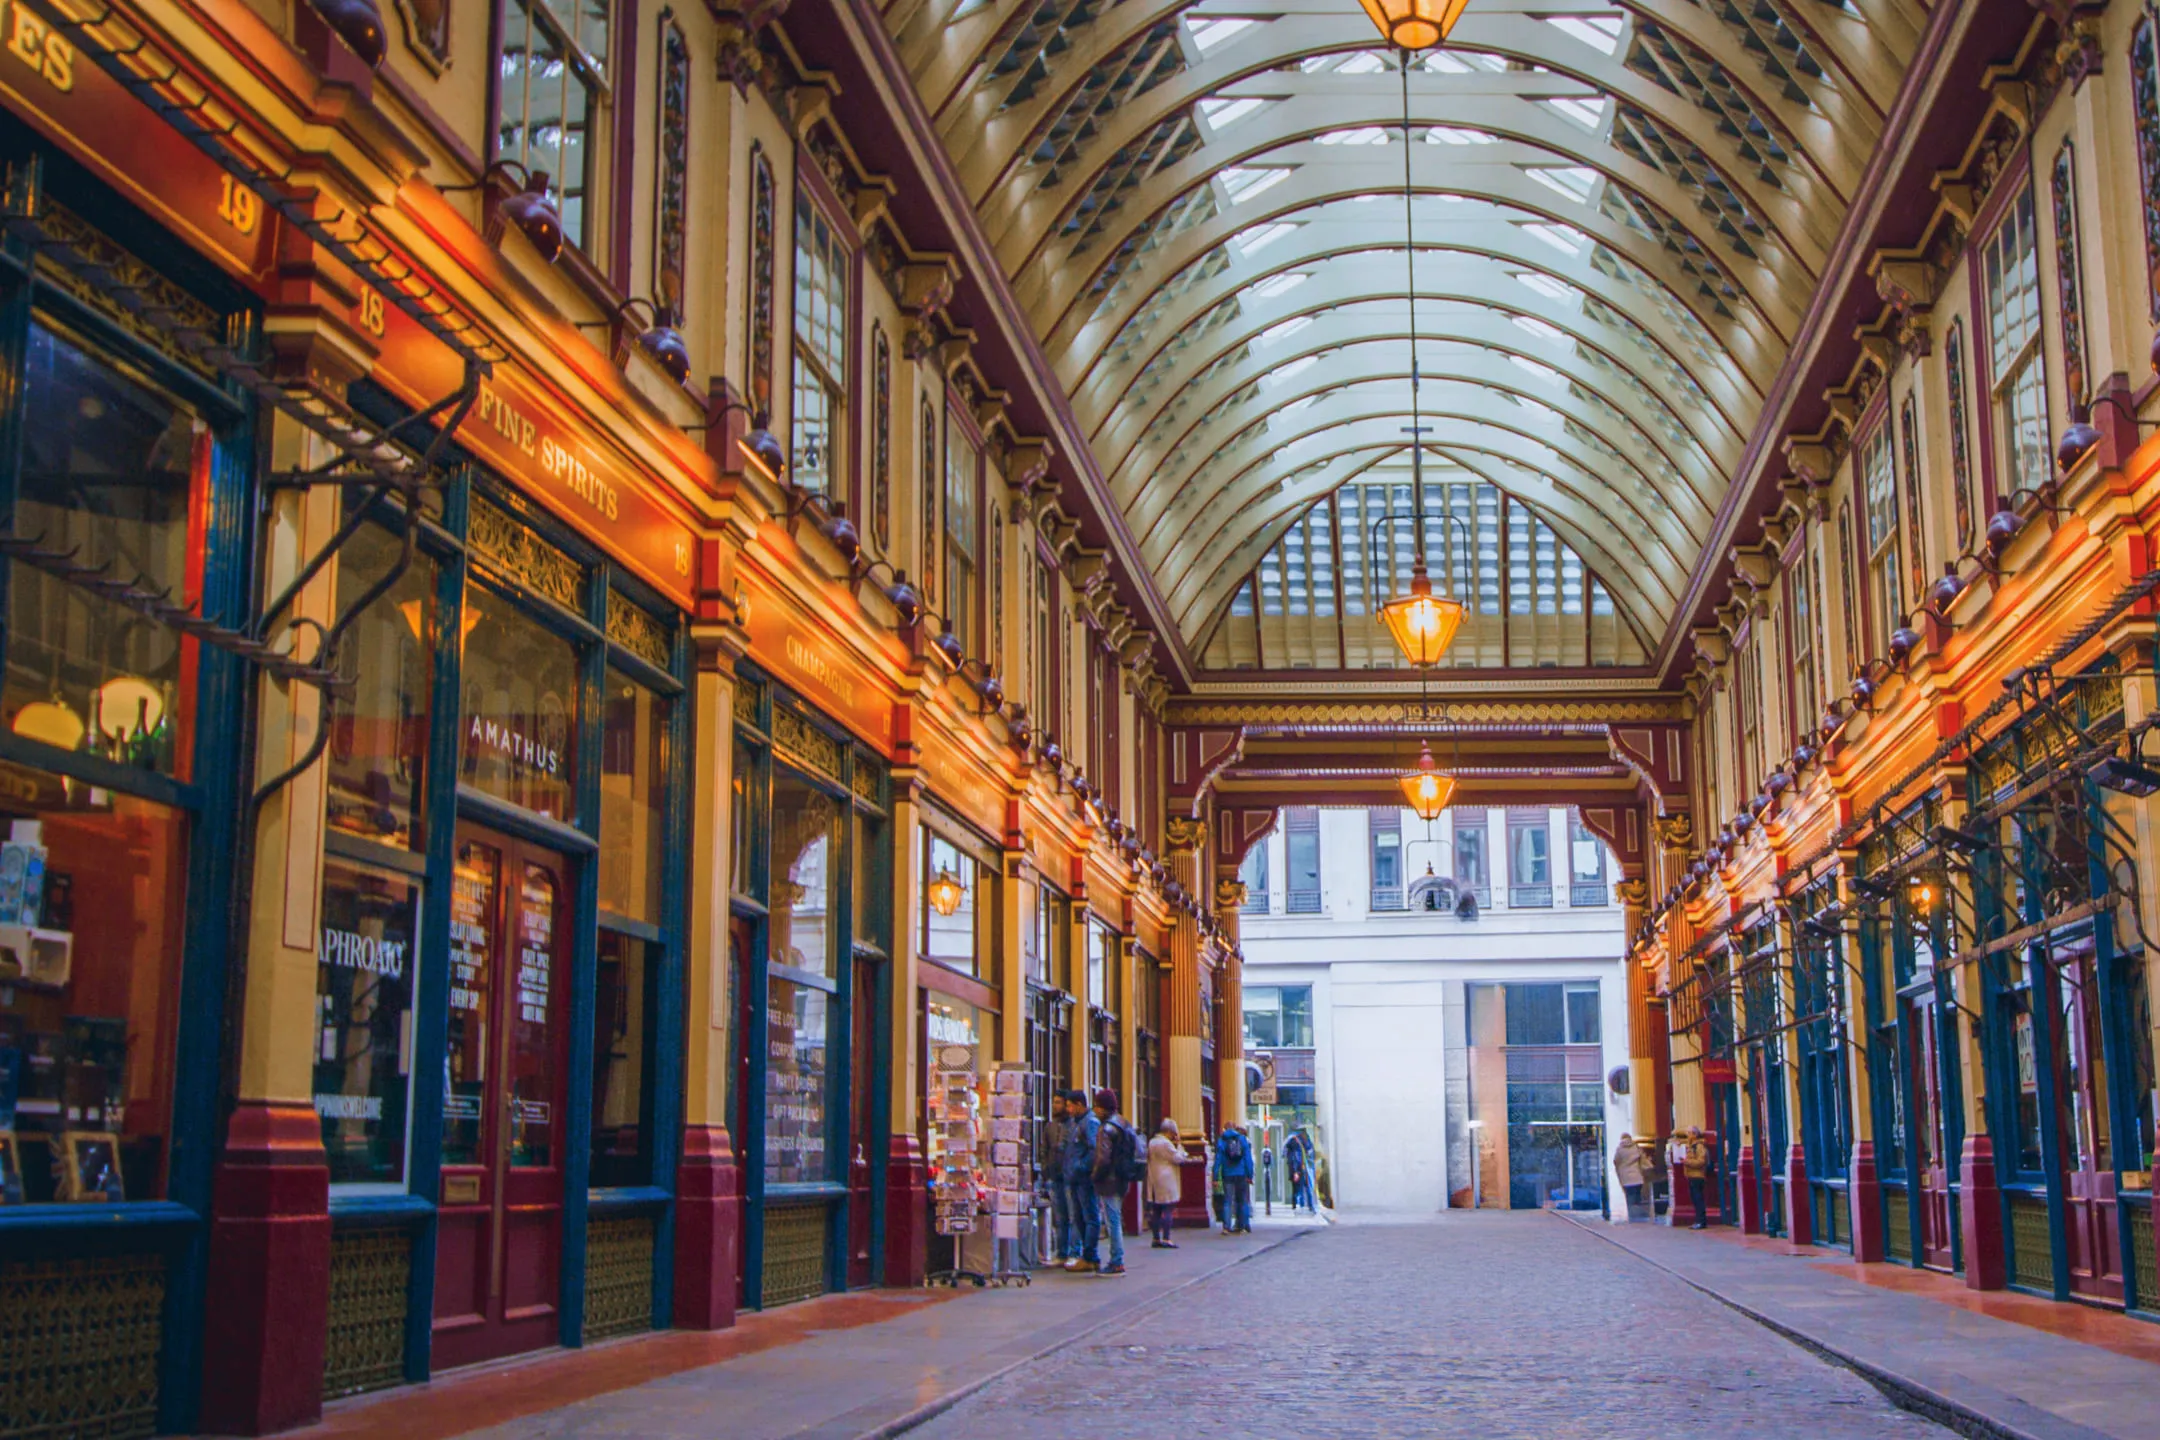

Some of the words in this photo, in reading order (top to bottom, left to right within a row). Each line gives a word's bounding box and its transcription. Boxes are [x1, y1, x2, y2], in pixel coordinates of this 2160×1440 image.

[0, 2, 73, 92] ES
[217, 172, 254, 234] 19
[359, 284, 384, 338] 18
[479, 384, 536, 458] FINE
[541, 436, 618, 521] SPIRITS
[786, 634, 854, 709] CHAMPAGNE
[471, 714, 558, 774] AMATHUS
